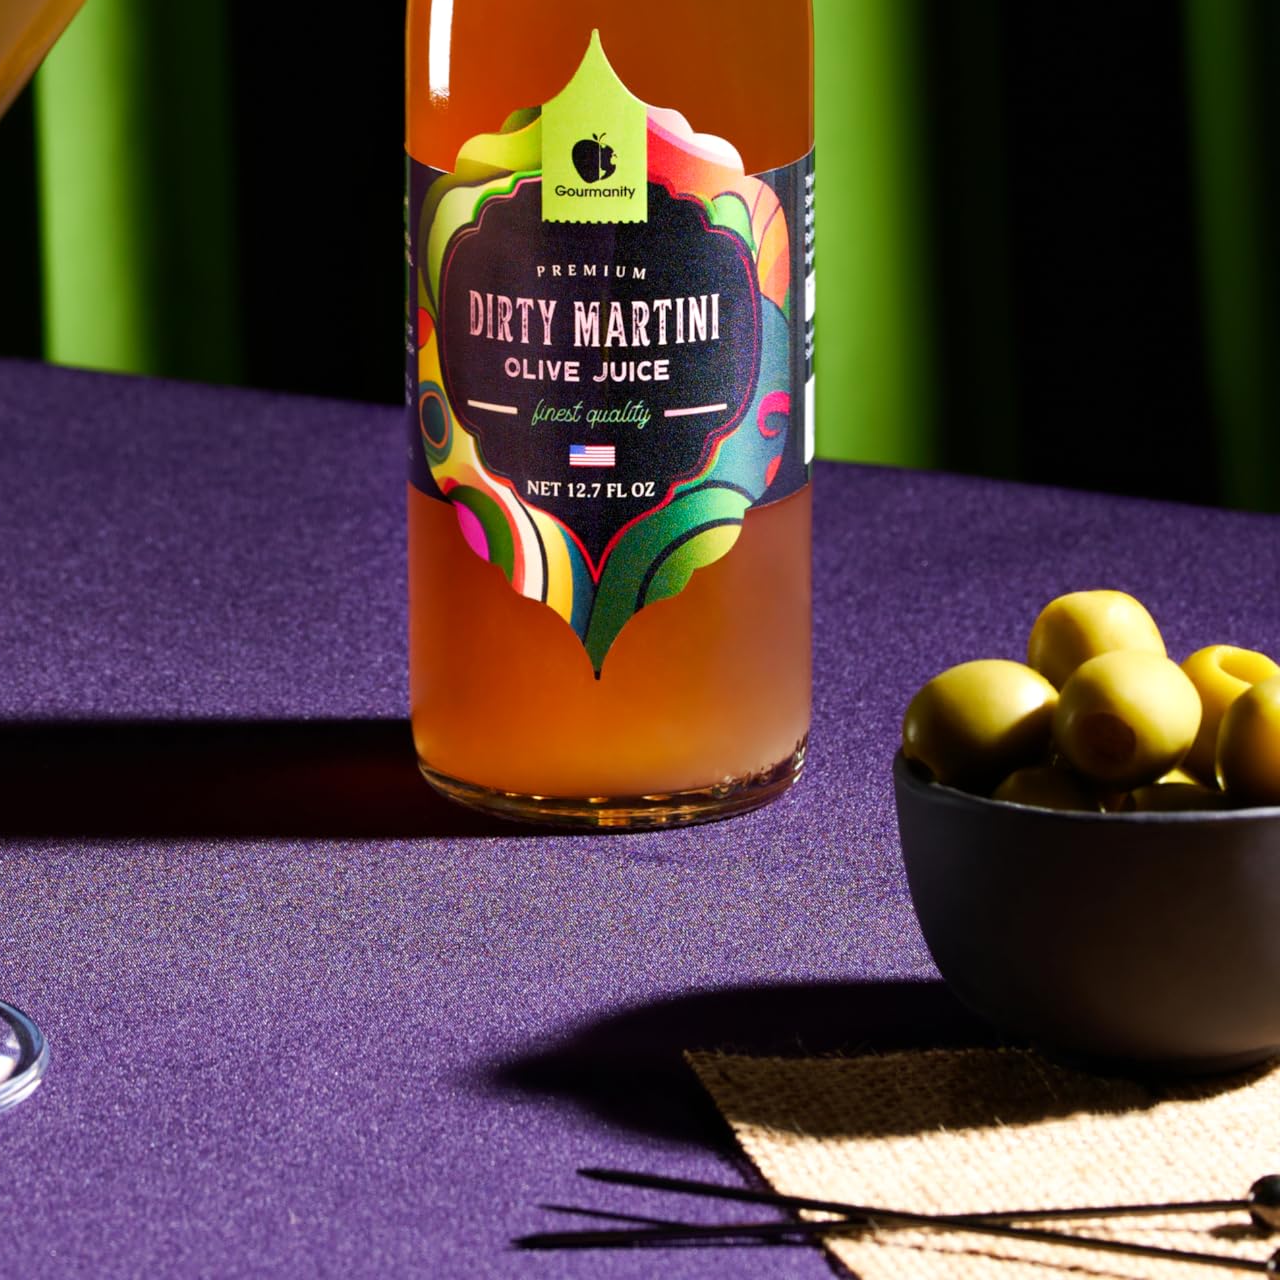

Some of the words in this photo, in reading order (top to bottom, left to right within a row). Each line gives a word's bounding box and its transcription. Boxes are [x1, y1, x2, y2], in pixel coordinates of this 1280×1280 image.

[554, 184, 636, 199] Gourmanity
[536, 264, 648, 281] PREMIUM
[468, 289, 557, 346] DIRTY
[574, 292, 721, 349] MARTINI
[504, 357, 580, 382] OLIVE
[592, 359, 670, 383] JUICE
[531, 399, 583, 425] finest
[586, 399, 652, 429] quality
[526, 479, 563, 497] NET
[567, 481, 602, 499] 12.7
[605, 481, 627, 499] FL
[630, 481, 656, 498] OZ
